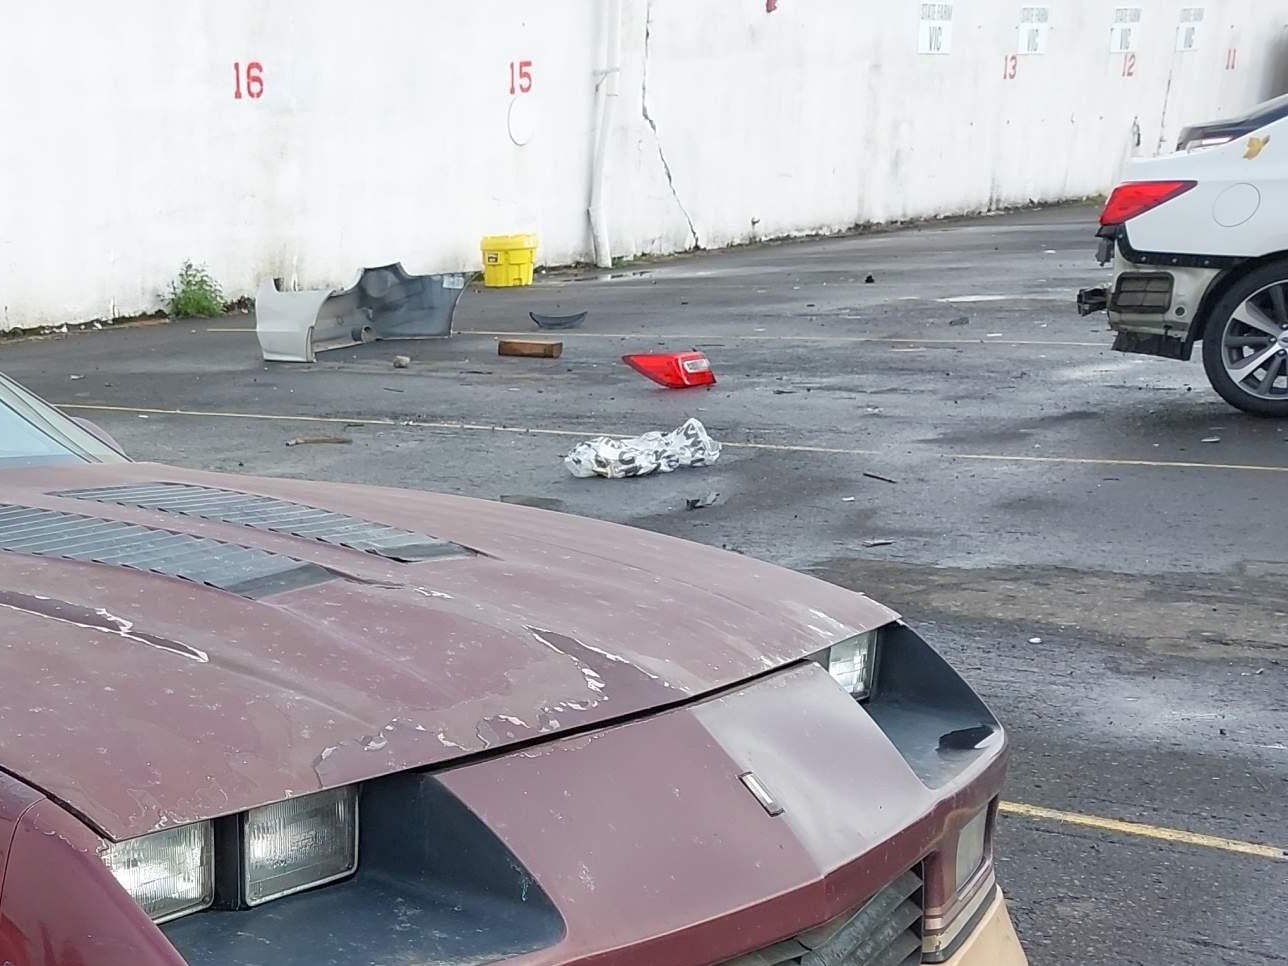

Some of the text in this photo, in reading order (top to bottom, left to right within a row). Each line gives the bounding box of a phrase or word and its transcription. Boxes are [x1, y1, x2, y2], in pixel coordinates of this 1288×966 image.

[508, 60, 533, 94] 15
[1002, 55, 1018, 80] 13
[1121, 52, 1136, 77] 12
[233, 61, 264, 99] 16
